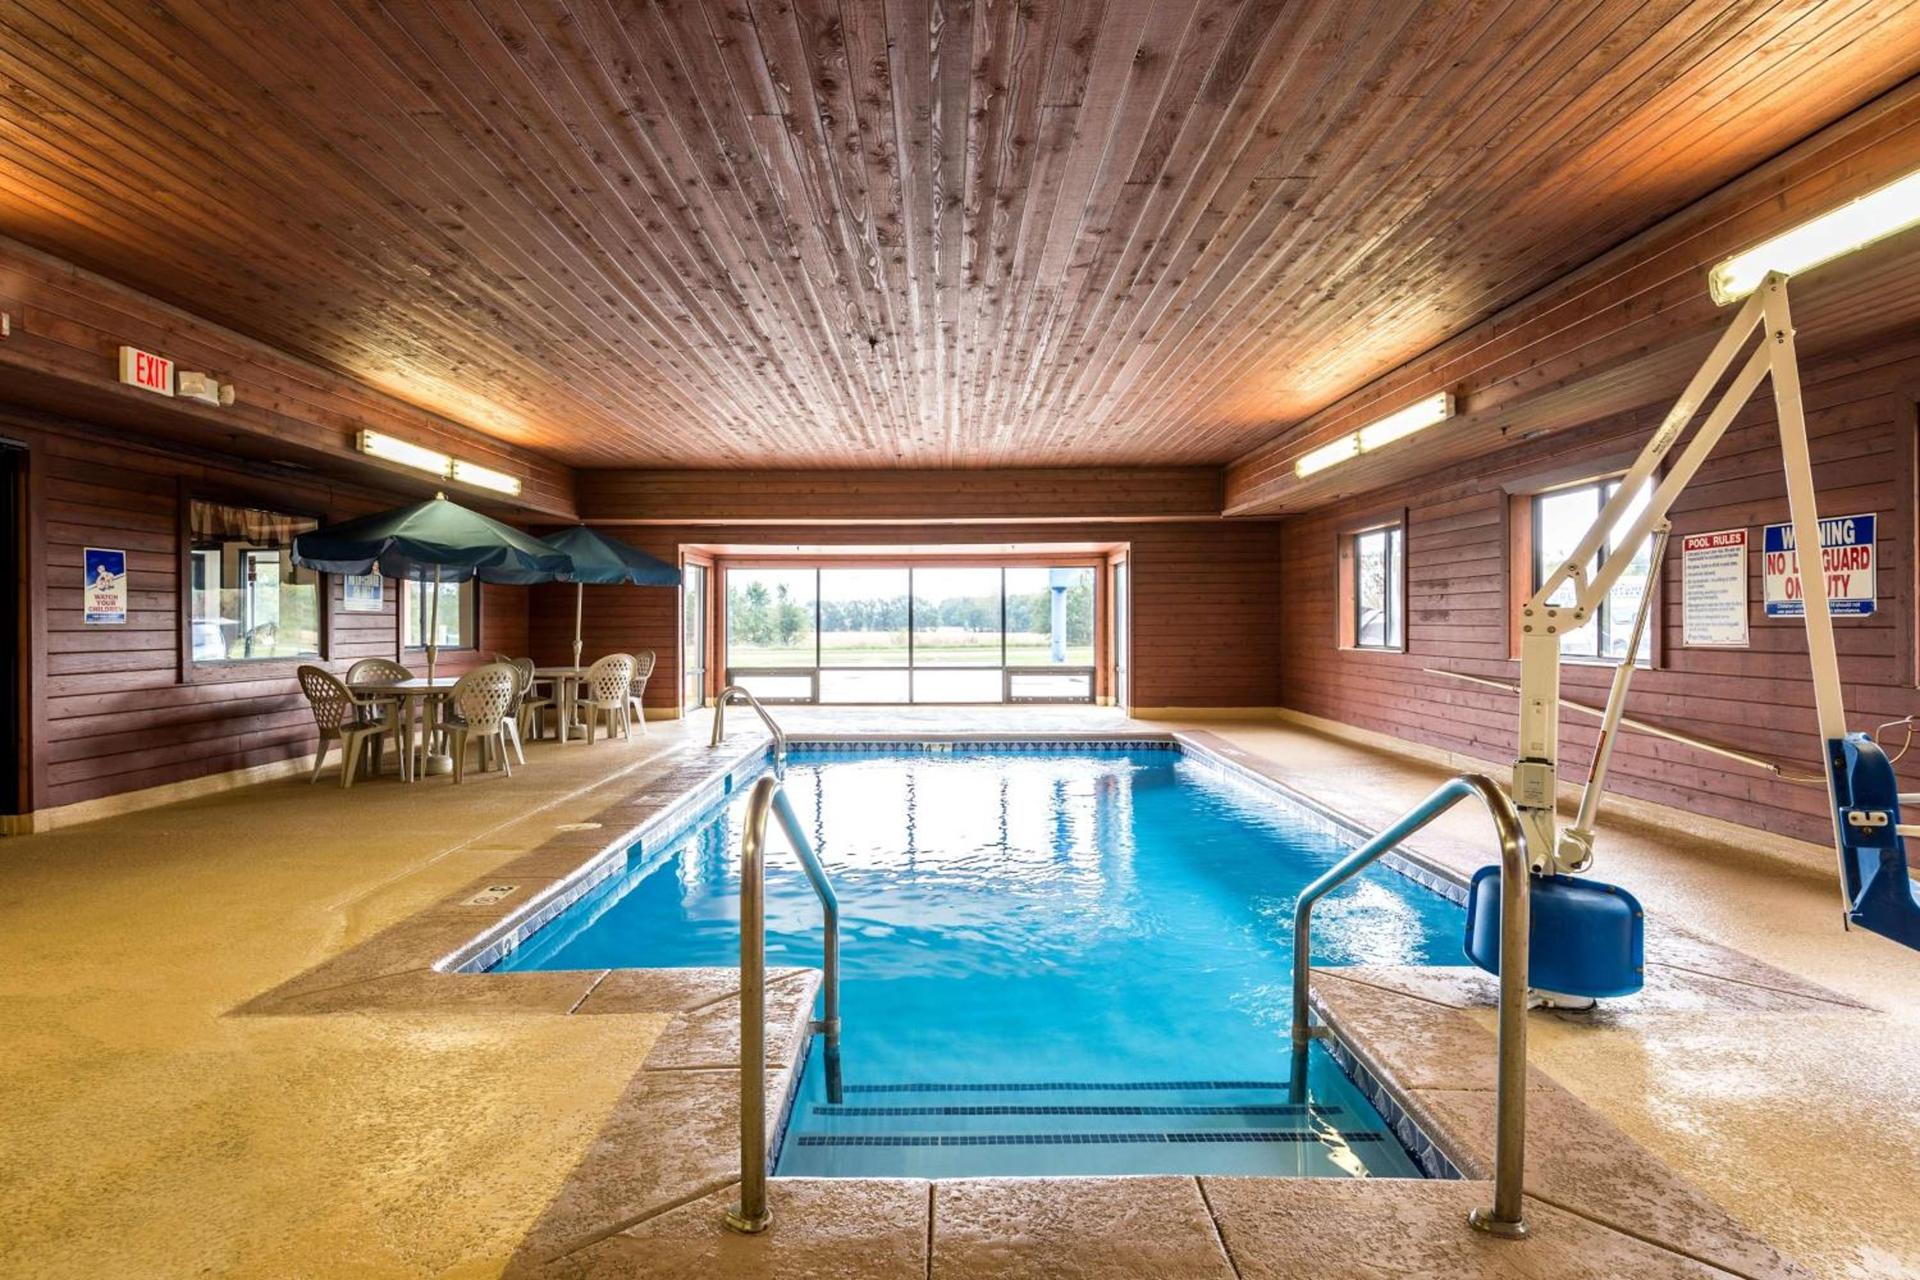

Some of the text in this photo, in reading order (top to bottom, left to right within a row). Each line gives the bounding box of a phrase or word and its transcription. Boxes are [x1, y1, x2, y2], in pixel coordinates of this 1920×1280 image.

[136, 351, 168, 390] EXIT
[1688, 533, 1742, 549] POOL RULES
[1781, 519, 1856, 550] WNING
[1767, 552, 1786, 575] NO
[1792, 546, 1870, 574] LGUARD
[1785, 576, 1803, 599] ON
